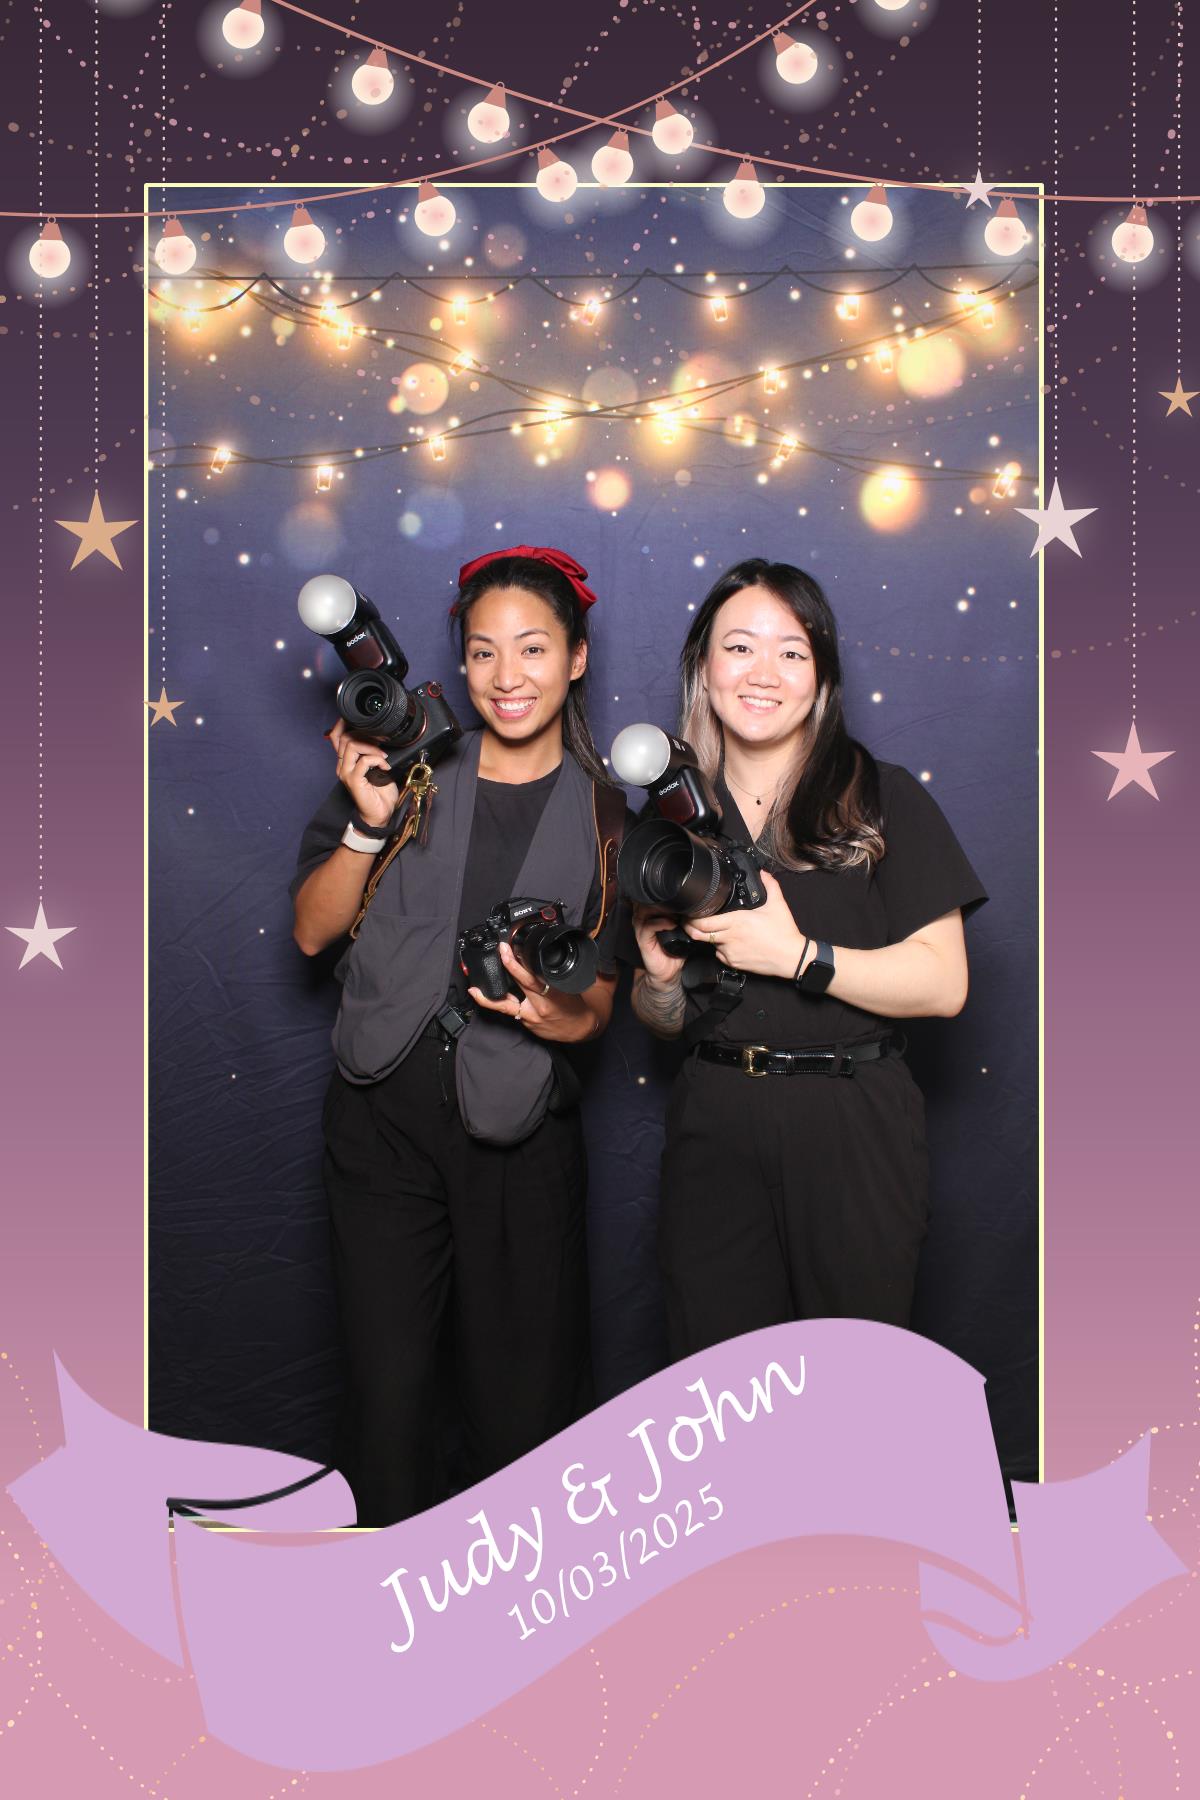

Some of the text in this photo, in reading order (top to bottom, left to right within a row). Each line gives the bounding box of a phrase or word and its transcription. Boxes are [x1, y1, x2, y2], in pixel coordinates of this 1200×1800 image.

[346, 632, 367, 648] Godox
[658, 780, 680, 796] Godox
[513, 906, 533, 917] SONY
